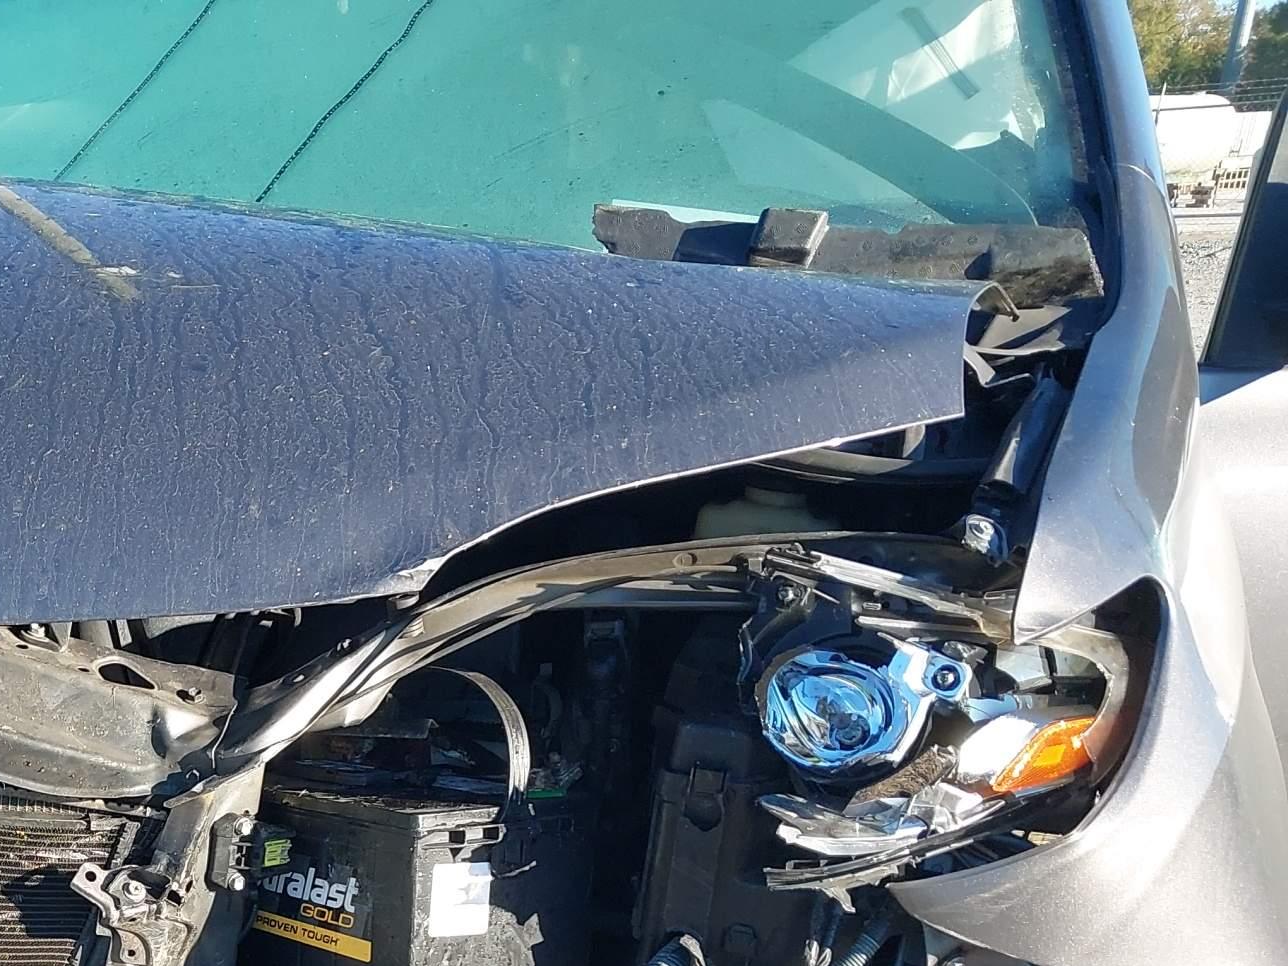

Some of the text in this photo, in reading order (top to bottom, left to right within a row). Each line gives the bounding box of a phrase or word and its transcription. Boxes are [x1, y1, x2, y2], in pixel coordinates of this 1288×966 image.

[262, 867, 360, 913] uralast
[255, 914, 339, 947] PROVEN TOUGH
[300, 903, 355, 928] GOLD
